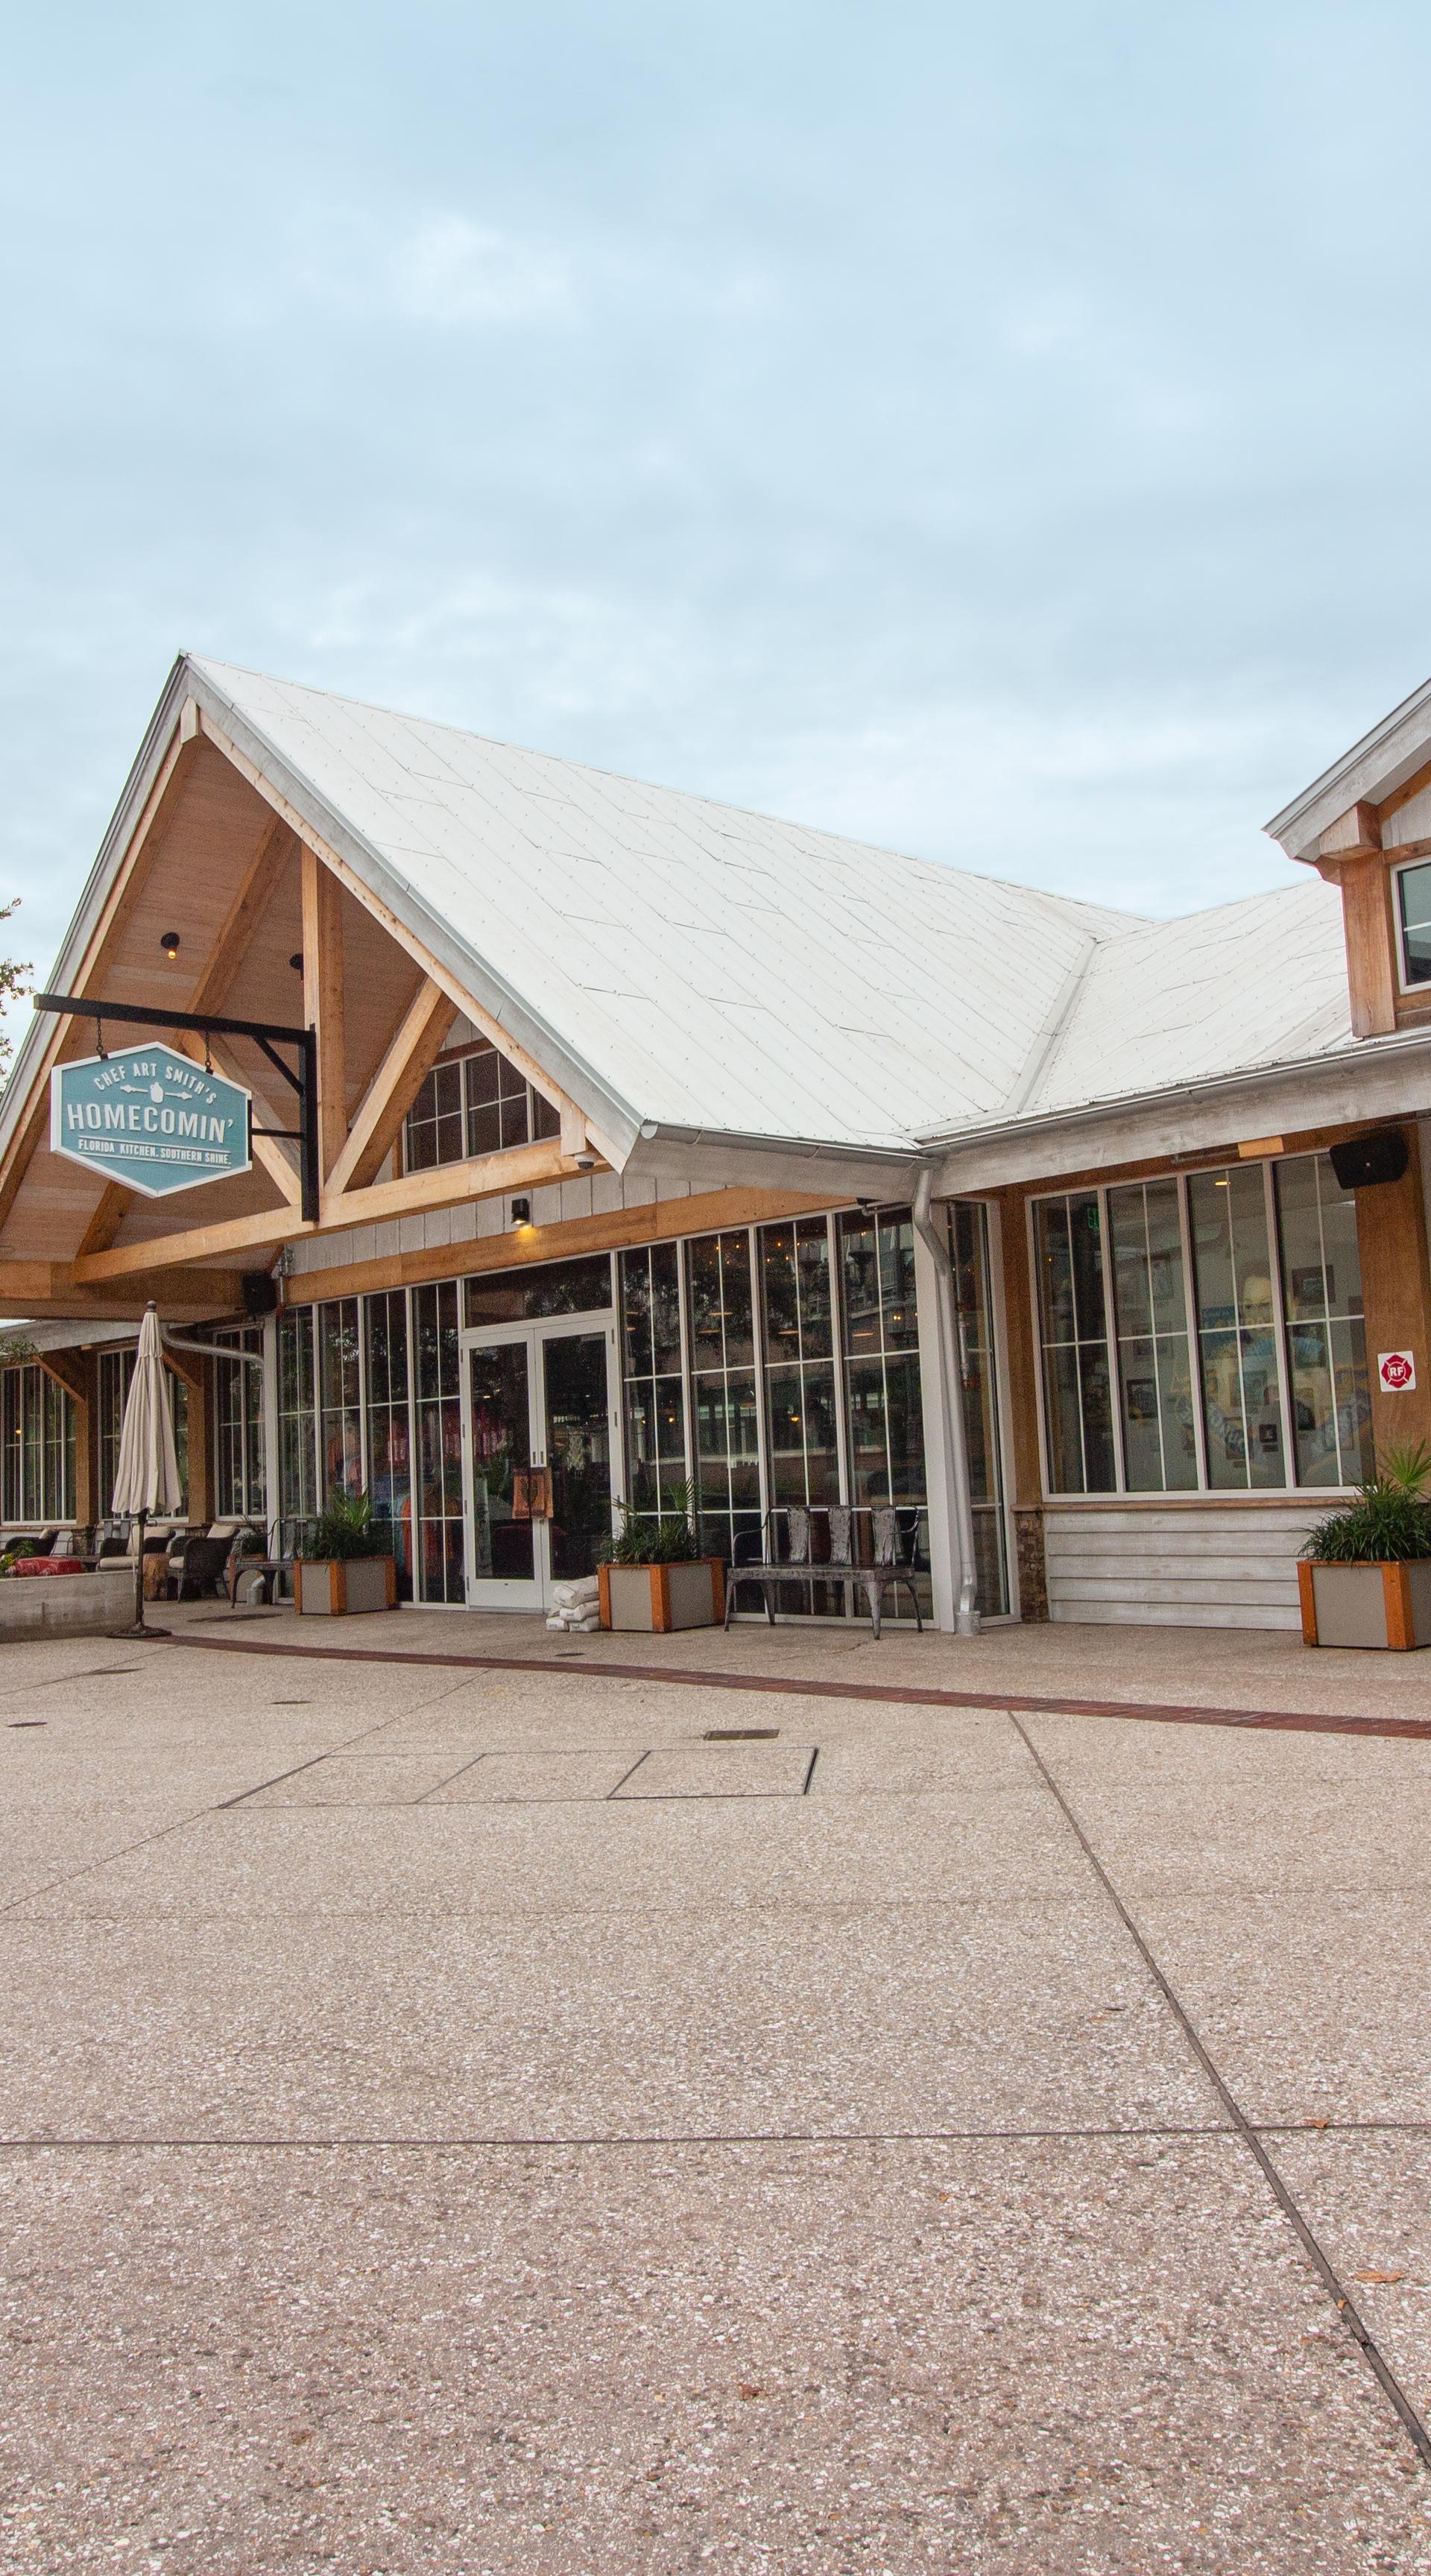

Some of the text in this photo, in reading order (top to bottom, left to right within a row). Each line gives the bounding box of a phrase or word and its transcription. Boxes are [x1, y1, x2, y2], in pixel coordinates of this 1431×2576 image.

[94, 1063, 217, 1105] CHEF ART SMITH'S
[66, 1103, 234, 1144] HOMECOMIN'
[78, 1139, 232, 1165] FLORIDA KITCHEN. SOUTHERN SHINE.
[1389, 1366, 1403, 1377] RF
